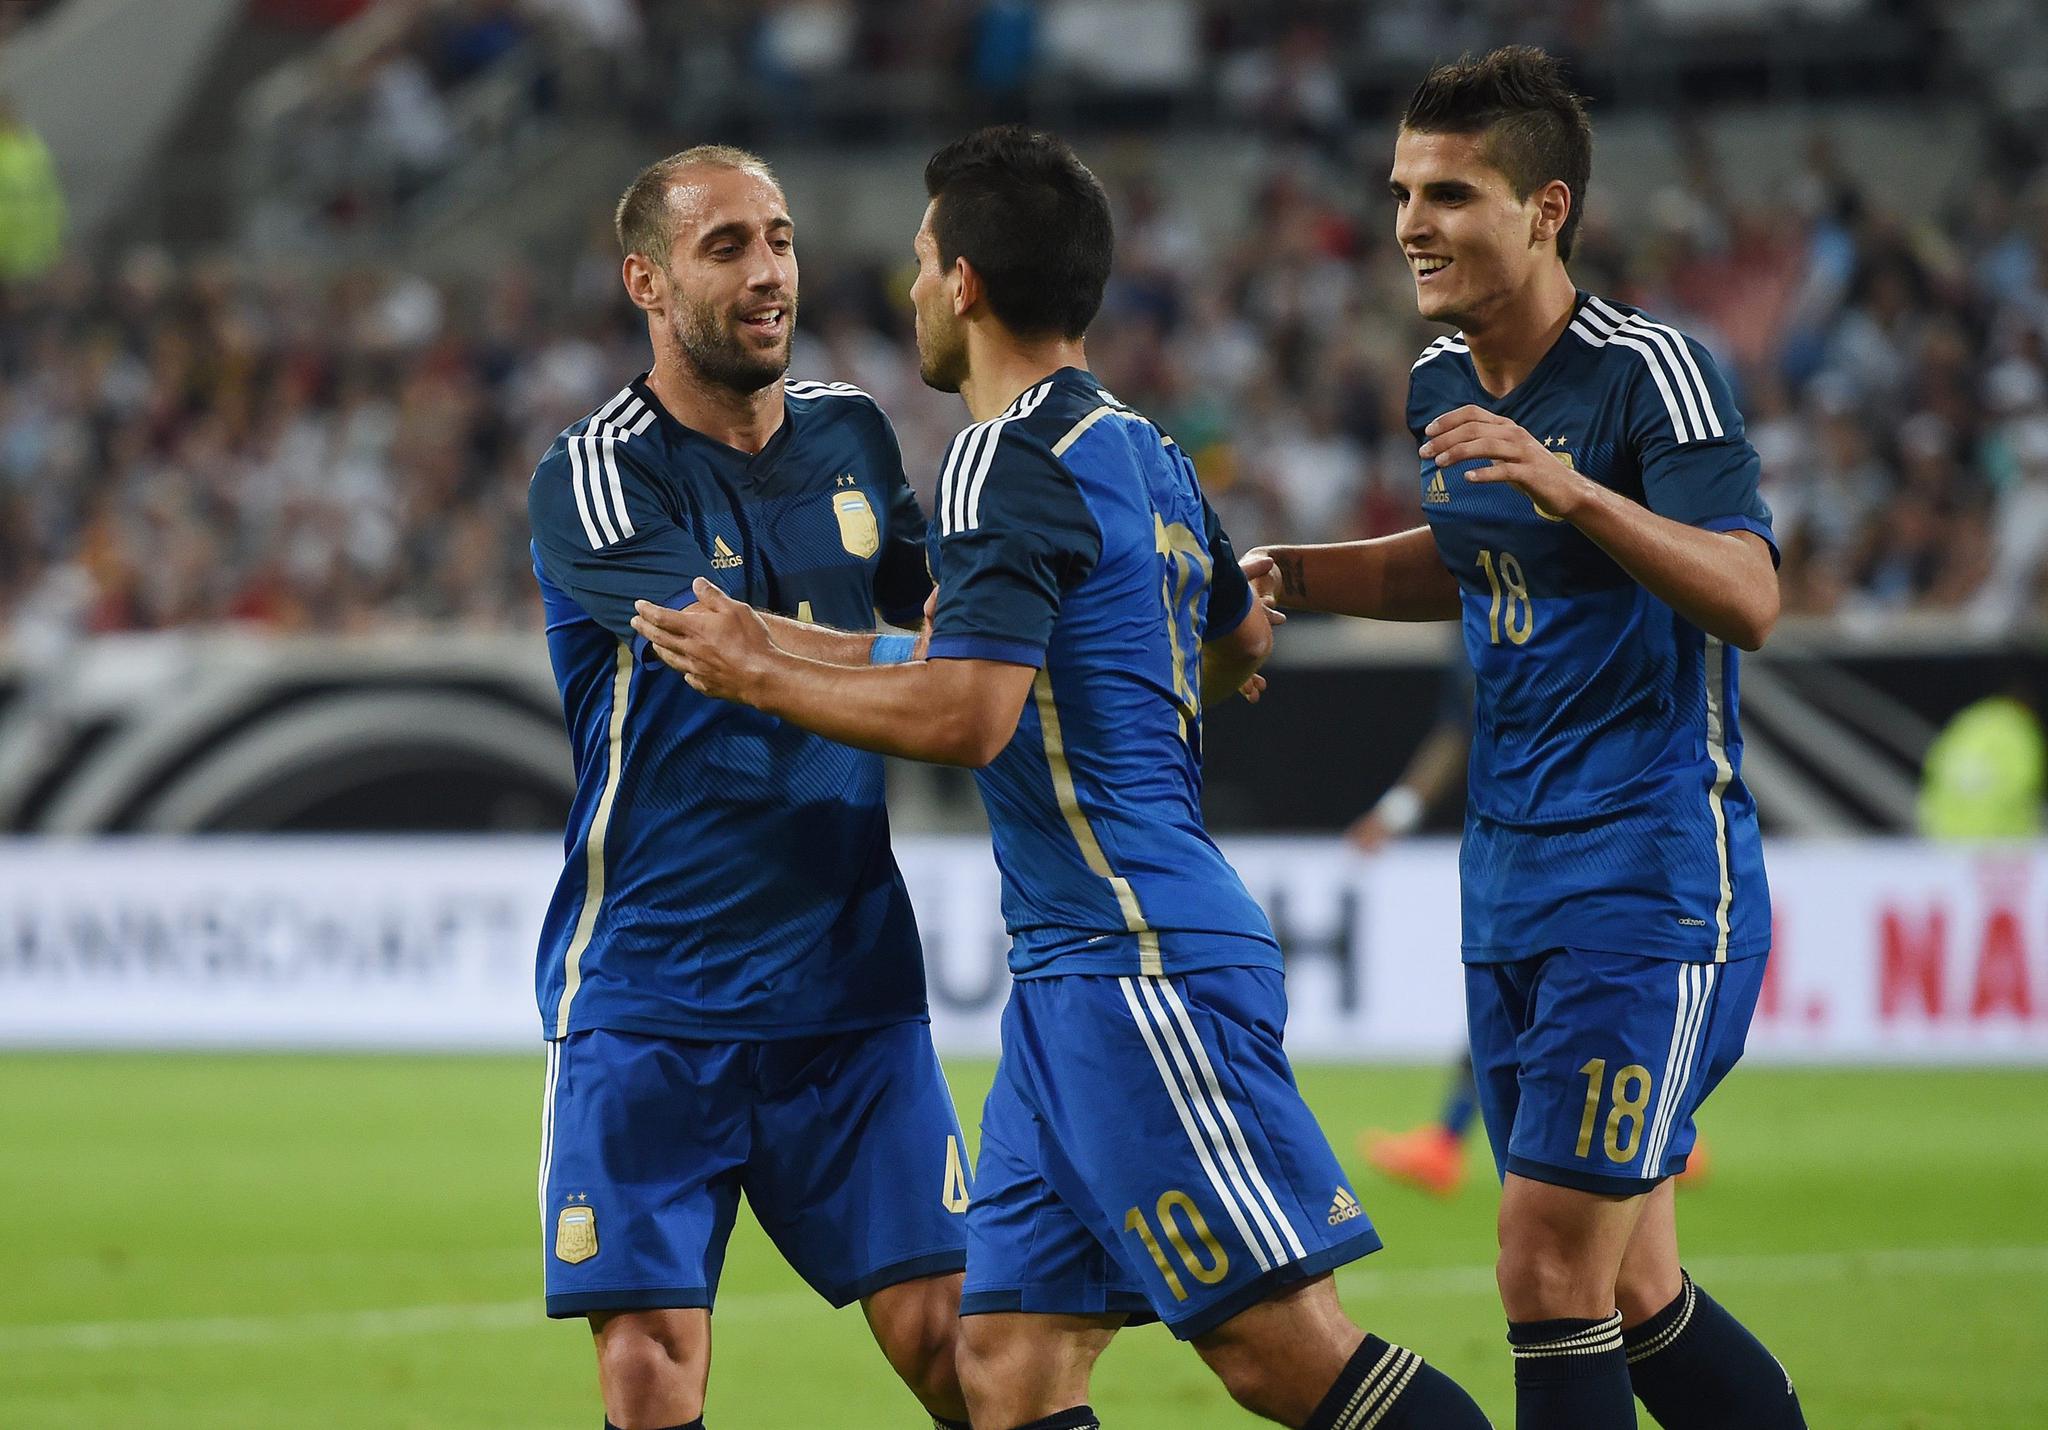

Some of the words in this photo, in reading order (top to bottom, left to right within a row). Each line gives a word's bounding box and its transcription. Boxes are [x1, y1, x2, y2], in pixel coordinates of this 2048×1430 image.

[1474, 550, 1534, 645] 18
[1575, 1057, 1652, 1164] 18
[1124, 1189, 1230, 1302] 10
[1328, 1204, 1362, 1226] adida
